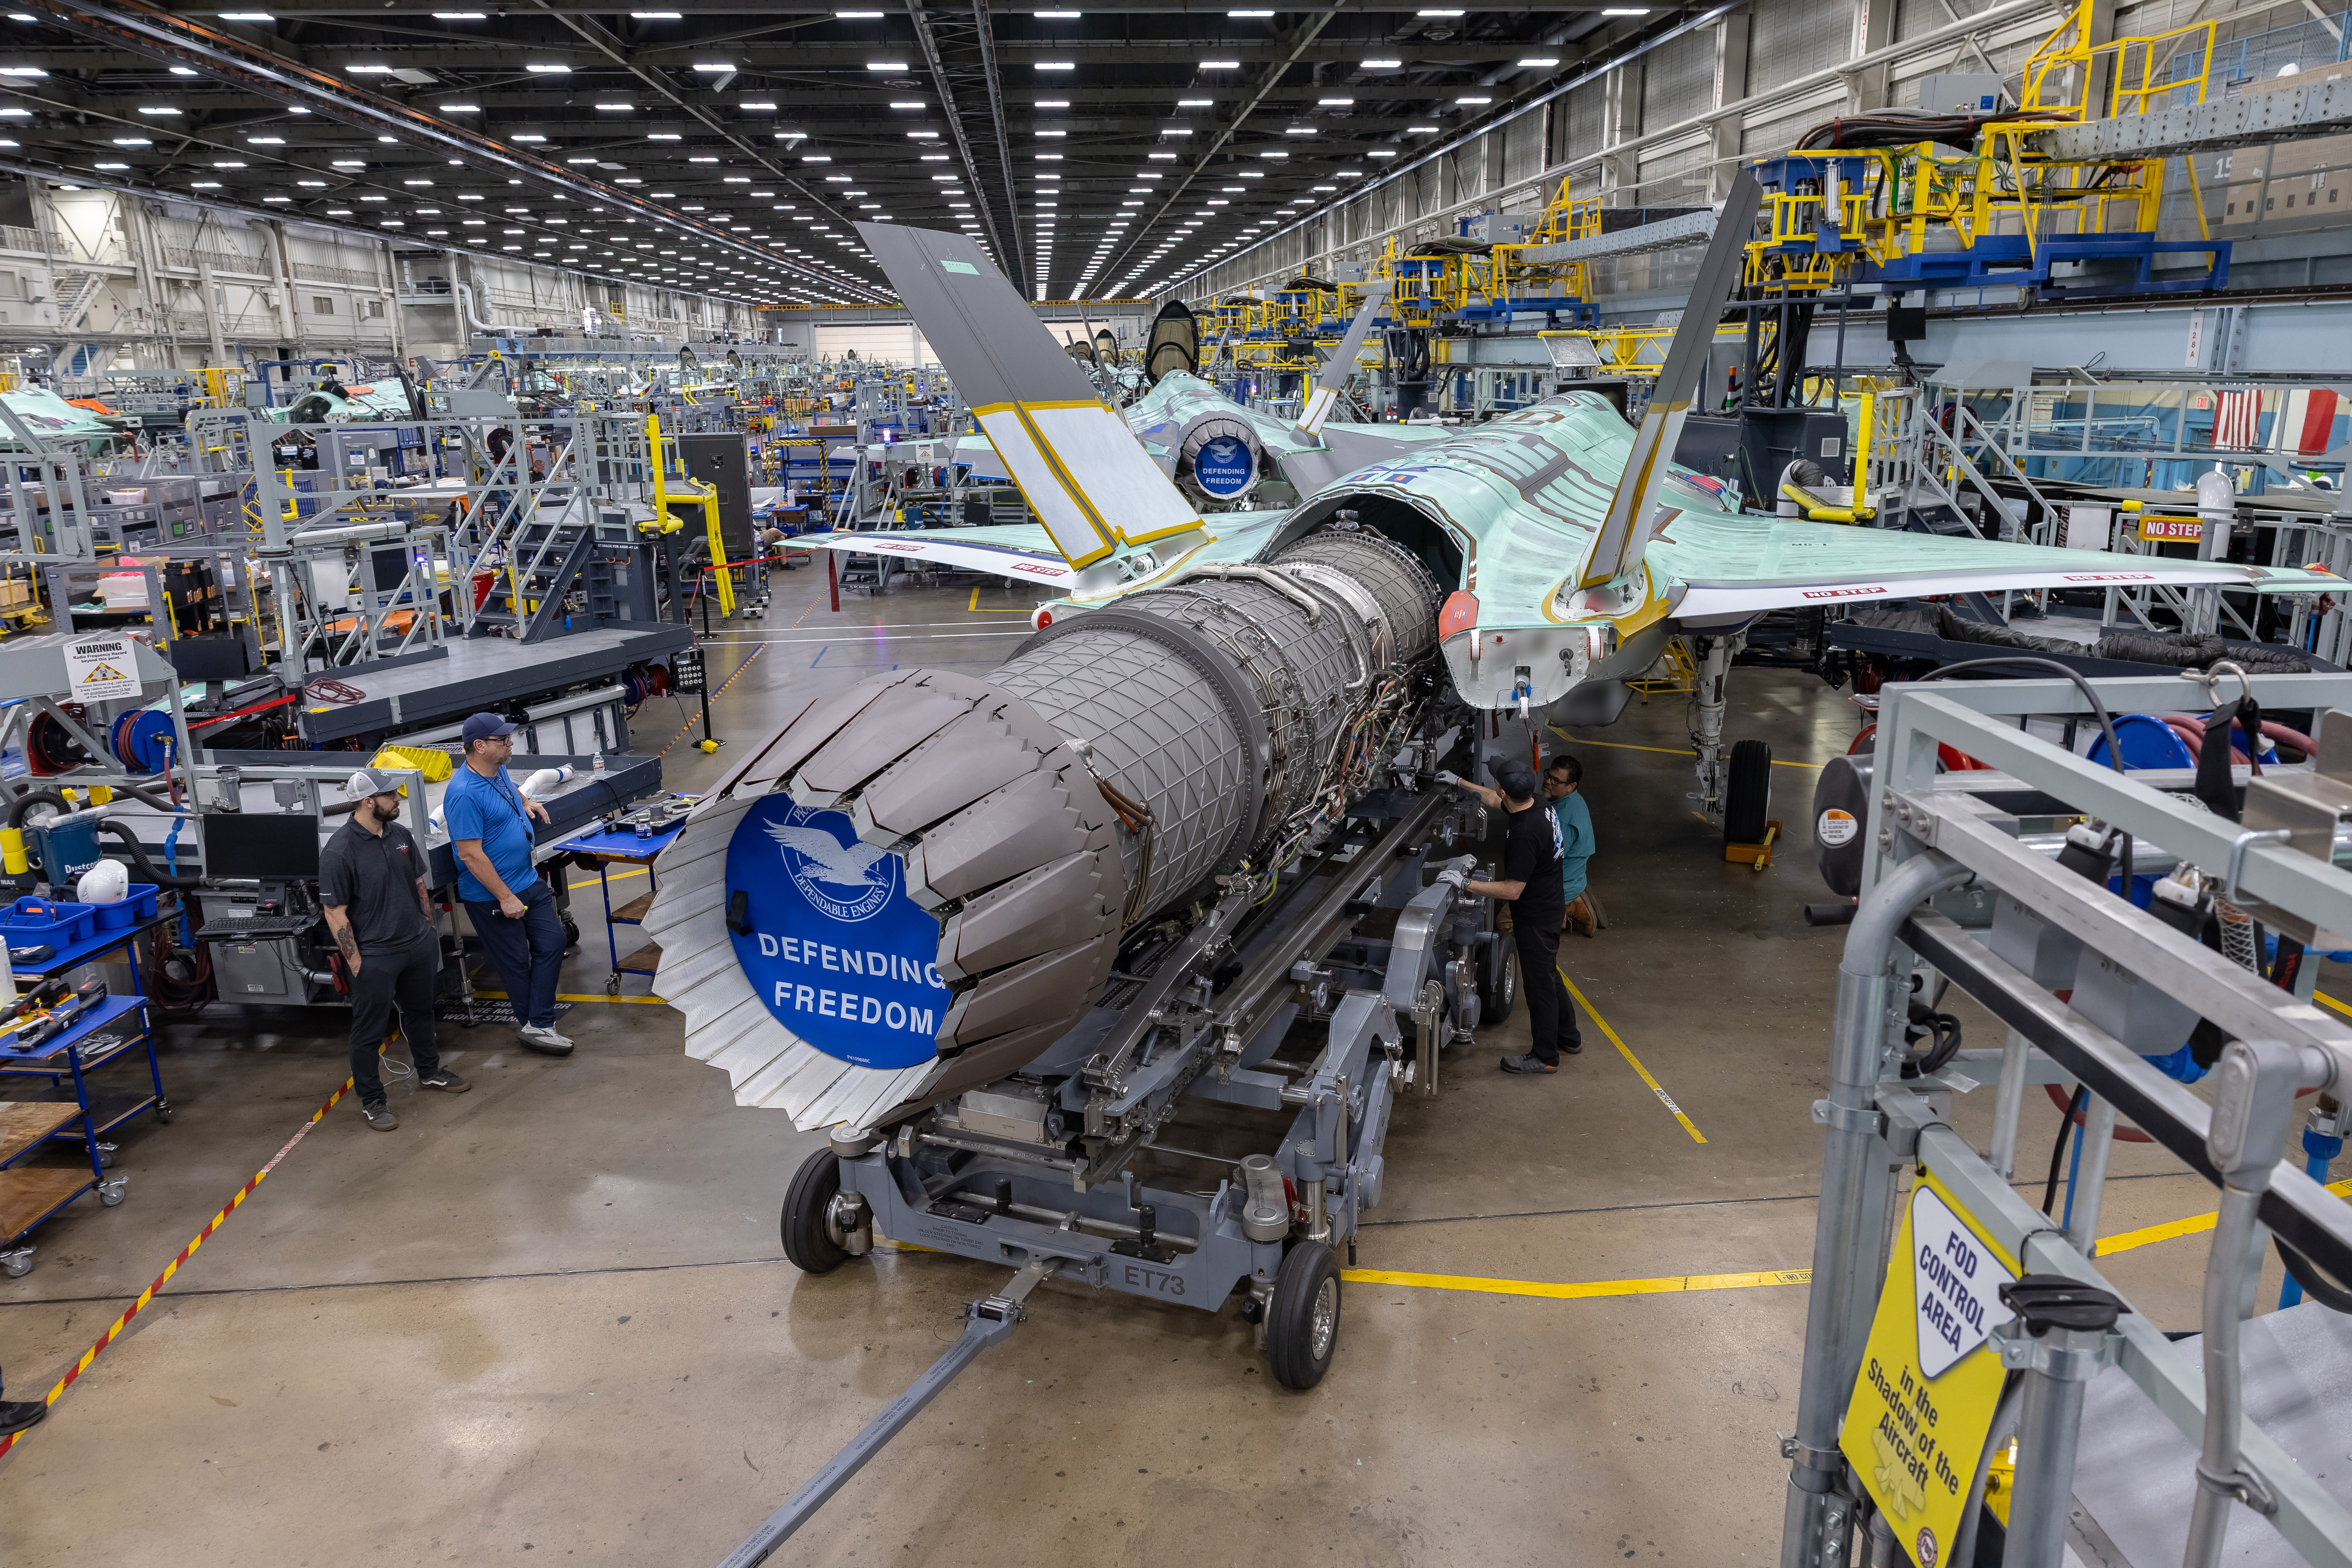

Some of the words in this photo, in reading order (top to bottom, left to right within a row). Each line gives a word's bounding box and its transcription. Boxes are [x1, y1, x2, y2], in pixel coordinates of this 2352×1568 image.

[2197, 397, 2207, 408] EXIT
[2147, 522, 2165, 534] NO
[2169, 523, 2202, 536] STEP
[1033, 567, 1065, 576] STEP
[1838, 588, 1881, 596] STEP
[75, 642, 122, 655] WARNING
[795, 873, 849, 917] DEPENDABLE
[850, 887, 885, 917] ENGINES
[759, 933, 946, 989] DEFENDING
[775, 981, 933, 1035] FREEDOM
[960, 1140, 979, 1149] WITHOUT
[957, 1241, 982, 1249] NON-TOWED
[1945, 1230, 1976, 1279] FOD
[1125, 1265, 1186, 1296] ET73
[1920, 1244, 1985, 1337] CONTROL
[1921, 1290, 1962, 1353] AREA
[964, 1336, 977, 1348] CAUTION
[947, 1351, 956, 1360] PRIOR
[929, 1364, 943, 1375] TOWING
[929, 1371, 942, 1381] BRAKE
[897, 1396, 907, 1406] PRIOR
[1899, 1364, 1914, 1397] in
[1916, 1386, 1938, 1428] the
[897, 1398, 912, 1411] CAUTION
[878, 1410, 892, 1423] TOWING
[888, 1412, 898, 1421] LOCK
[871, 1421, 889, 1436] STEERING
[1867, 1357, 1918, 1436] Shadow
[1918, 1432, 1936, 1460] of
[1936, 1450, 1959, 1496] the
[855, 1441, 867, 1450] RODS
[1878, 1411, 1928, 1492] Aircraft
[815, 1471, 832, 1485] TOWING
[806, 1485, 817, 1494] WITH
[791, 1493, 808, 1507] ENGINE
